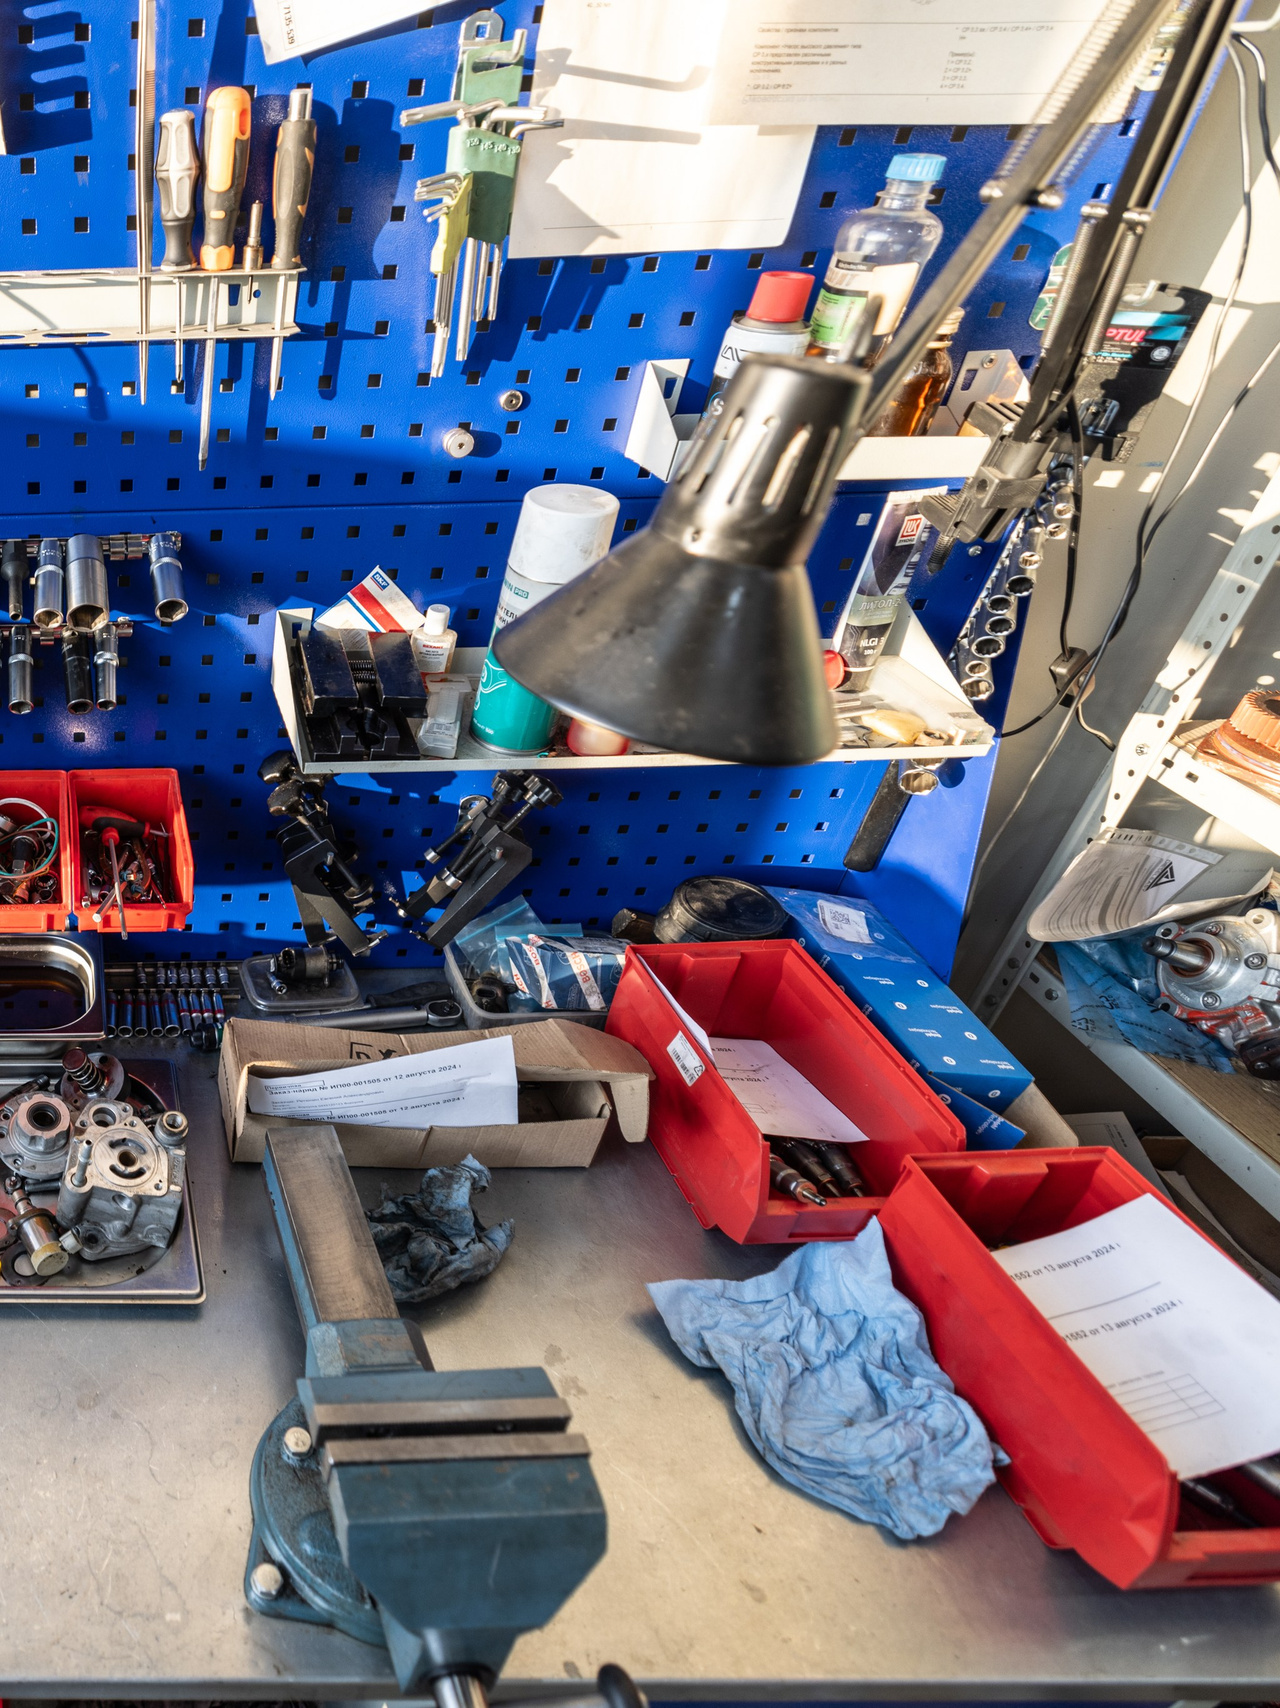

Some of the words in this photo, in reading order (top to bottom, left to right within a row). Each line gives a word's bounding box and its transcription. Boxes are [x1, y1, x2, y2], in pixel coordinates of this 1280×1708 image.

[373, 572, 388, 588] SKF
[514, 587, 529, 598] PRO
[859, 598, 901, 612] ЛИТОЛ-2
[859, 637, 878, 647] NLGI
[570, 951, 591, 984] BOSCH
[269, 1087, 318, 1096] Заказ-наряд
[405, 1068, 437, 1080] августа
[438, 1064, 457, 1073] 2024
[409, 1101, 441, 1111] августа
[441, 1097, 461, 1105] 2024
[1010, 1270, 1031, 1282] 1552
[1032, 1267, 1043, 1276] от
[1044, 1264, 1056, 1274] 13
[1057, 1254, 1092, 1271] августа
[1093, 1244, 1116, 1259] 2024
[1063, 1329, 1088, 1343] 1552
[1089, 1327, 1100, 1336] от
[1101, 1322, 1114, 1334] 13
[1115, 1311, 1153, 1330] августа
[1151, 1300, 1177, 1316] 2024
